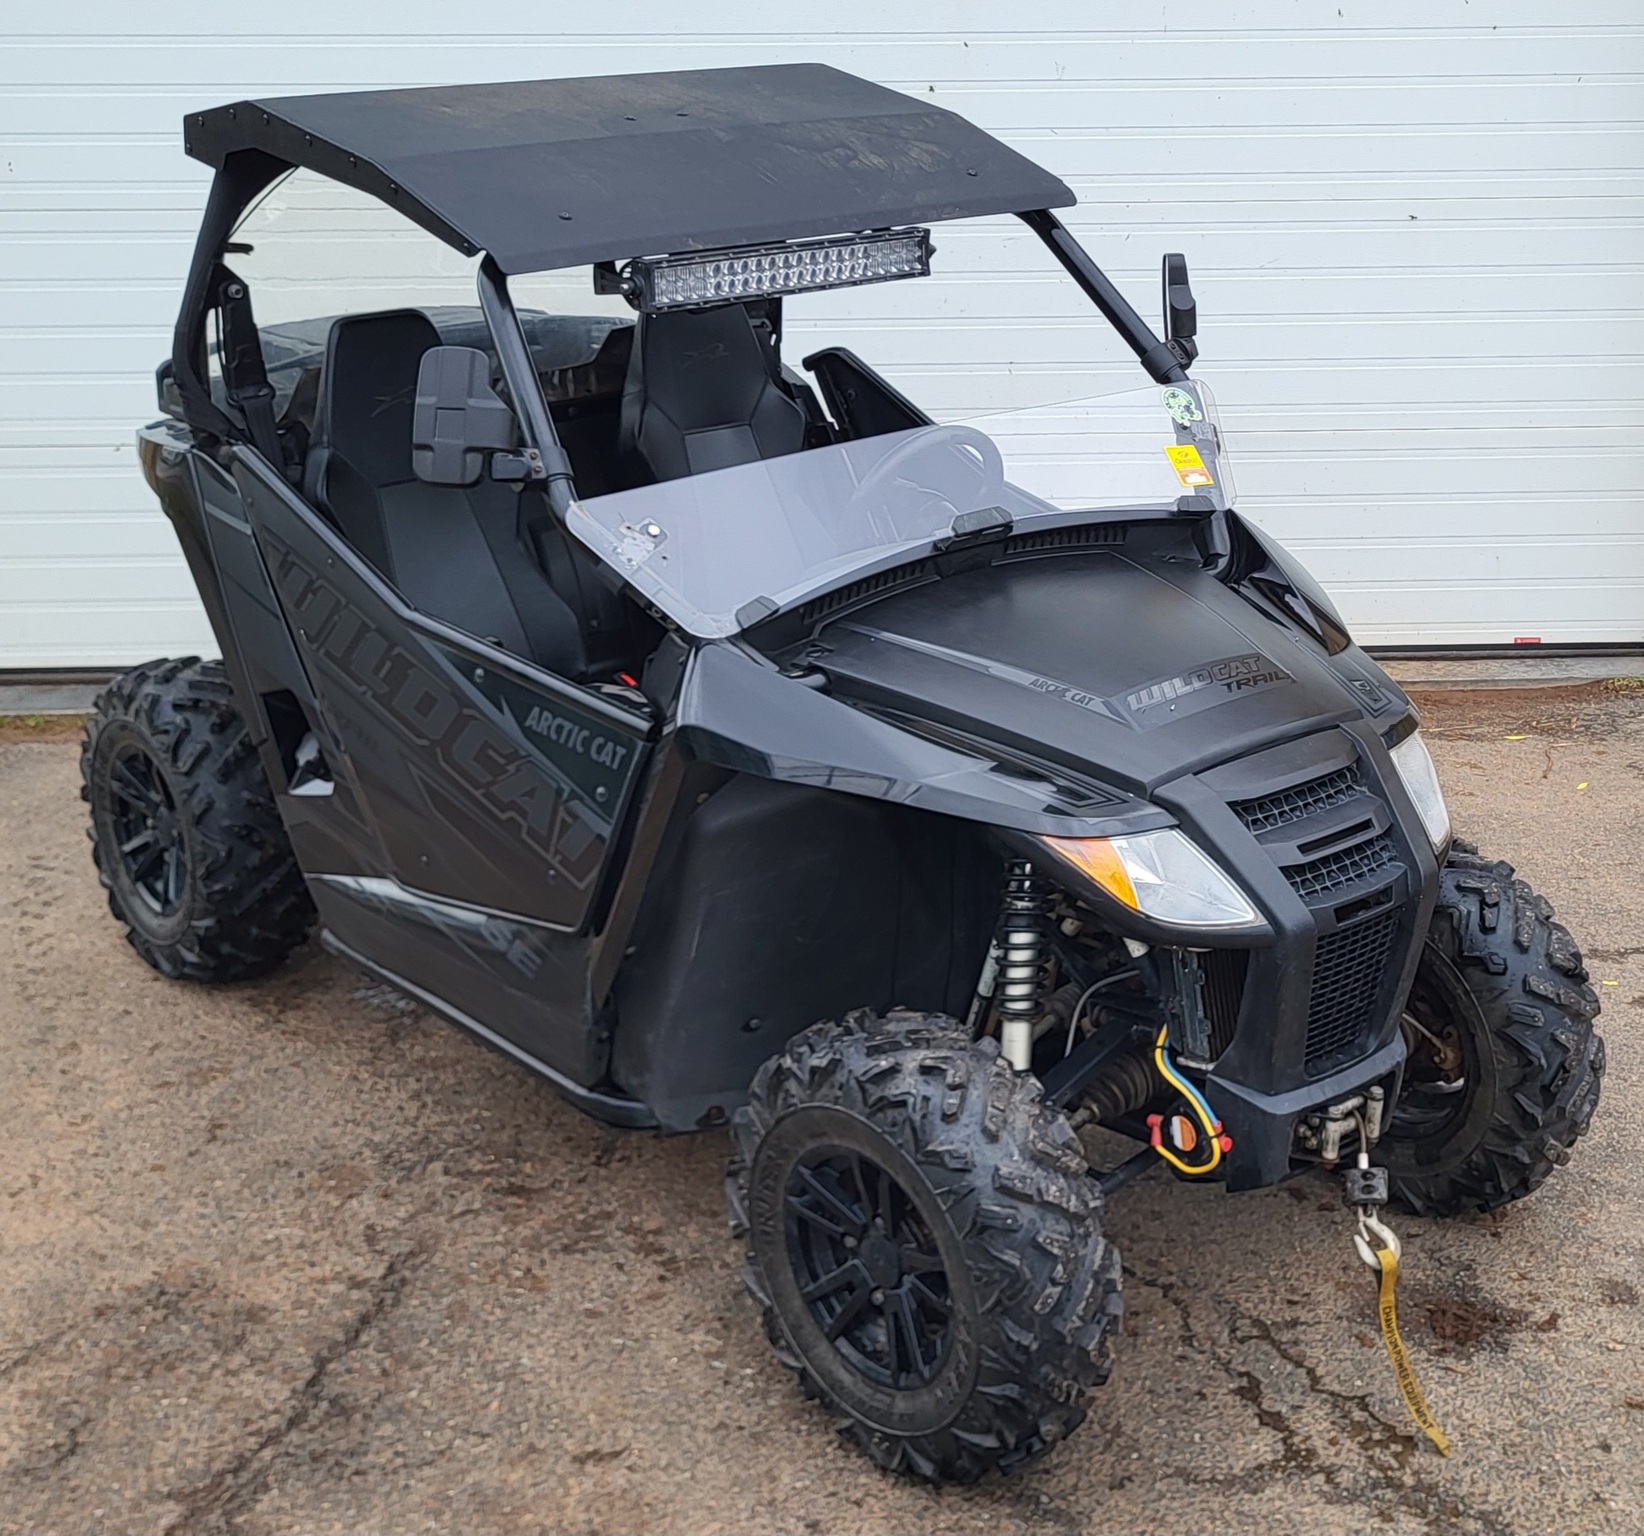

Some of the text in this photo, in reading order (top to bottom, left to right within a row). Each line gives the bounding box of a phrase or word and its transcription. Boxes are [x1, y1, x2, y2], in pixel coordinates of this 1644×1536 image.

[270, 544, 606, 872] WILDCAT
[1028, 679, 1096, 706] ARCTC CAT
[1127, 656, 1260, 711] WILDCAT
[1220, 671, 1289, 693] TRAIL
[525, 706, 627, 770] ARCTIC CAT
[1382, 1305, 1435, 1430] CHAMPION POWER EQUIPMENT
